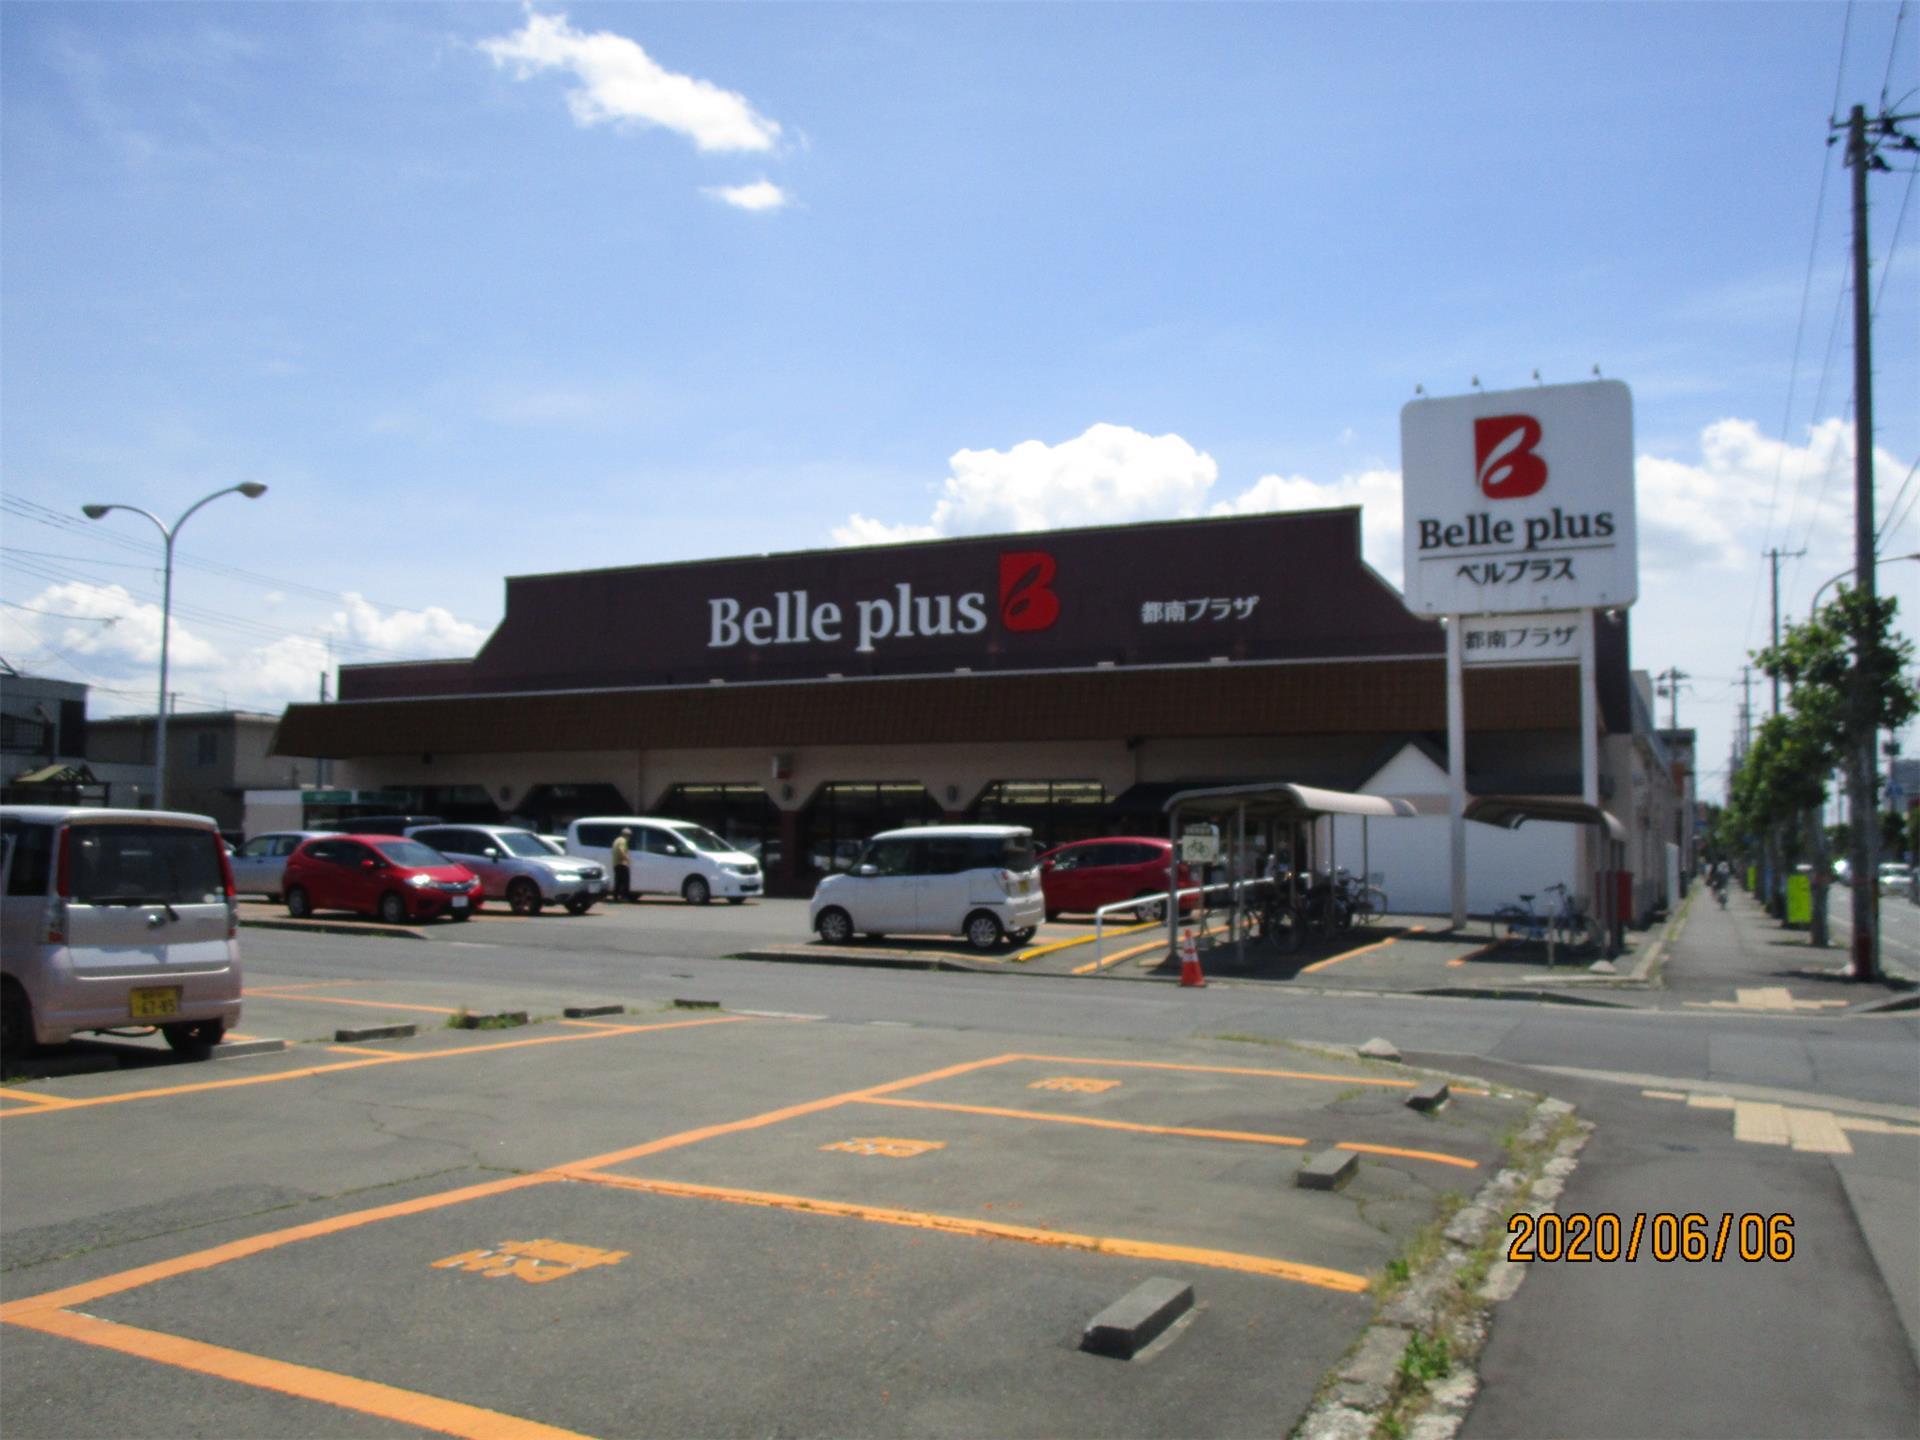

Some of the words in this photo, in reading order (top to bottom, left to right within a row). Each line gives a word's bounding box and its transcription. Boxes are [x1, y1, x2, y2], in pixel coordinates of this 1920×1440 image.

[1418, 512, 1514, 550] Belle
[1525, 507, 1616, 551] plus
[1455, 557, 1576, 585] ベルプラス
[706, 590, 843, 648] Belle
[855, 582, 988, 652] plus
[1140, 596, 1260, 625] 都南プラザ
[1464, 625, 1578, 650] 都南プラザ
